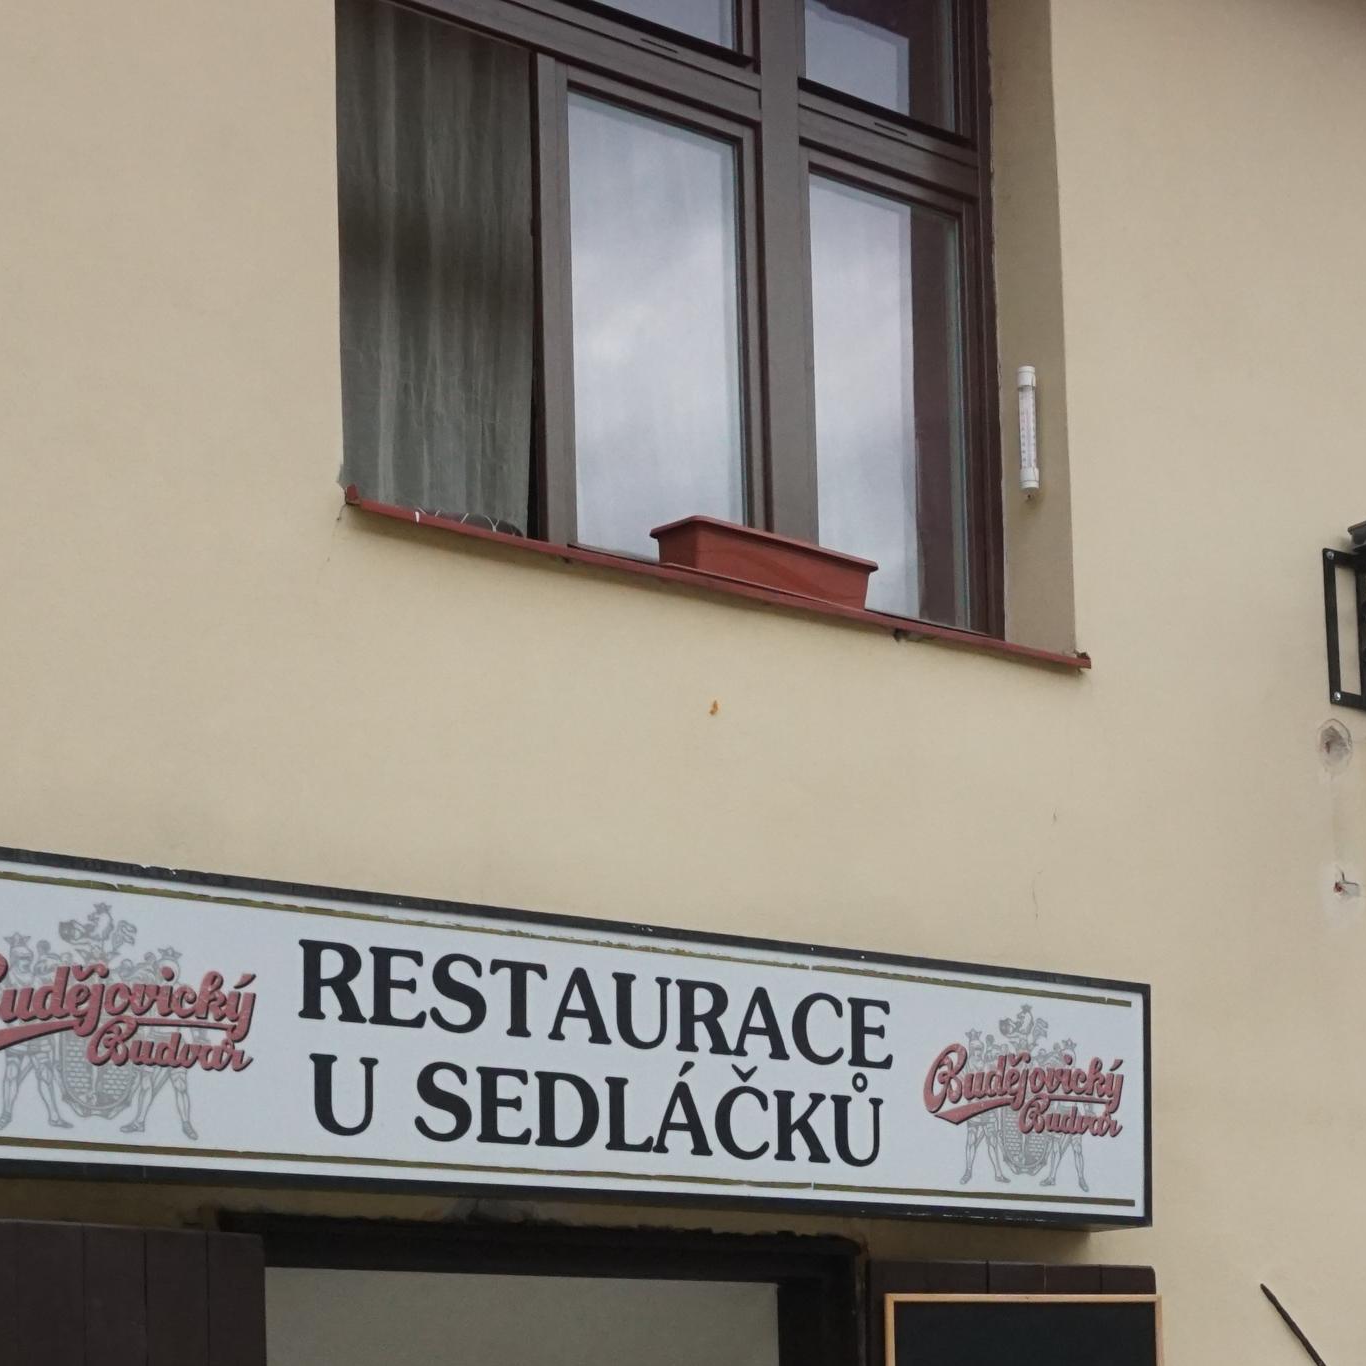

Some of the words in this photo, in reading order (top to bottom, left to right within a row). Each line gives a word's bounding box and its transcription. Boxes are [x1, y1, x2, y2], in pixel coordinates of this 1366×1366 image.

[297, 937, 894, 1071] RESTAURACE
[86, 1017, 255, 1073] Budvar
[922, 1042, 1125, 1117] Budějovický
[309, 1053, 379, 1137] U
[414, 1060, 885, 1169] SEDLÁČKŮ
[1018, 1096, 1124, 1139] Budvar
